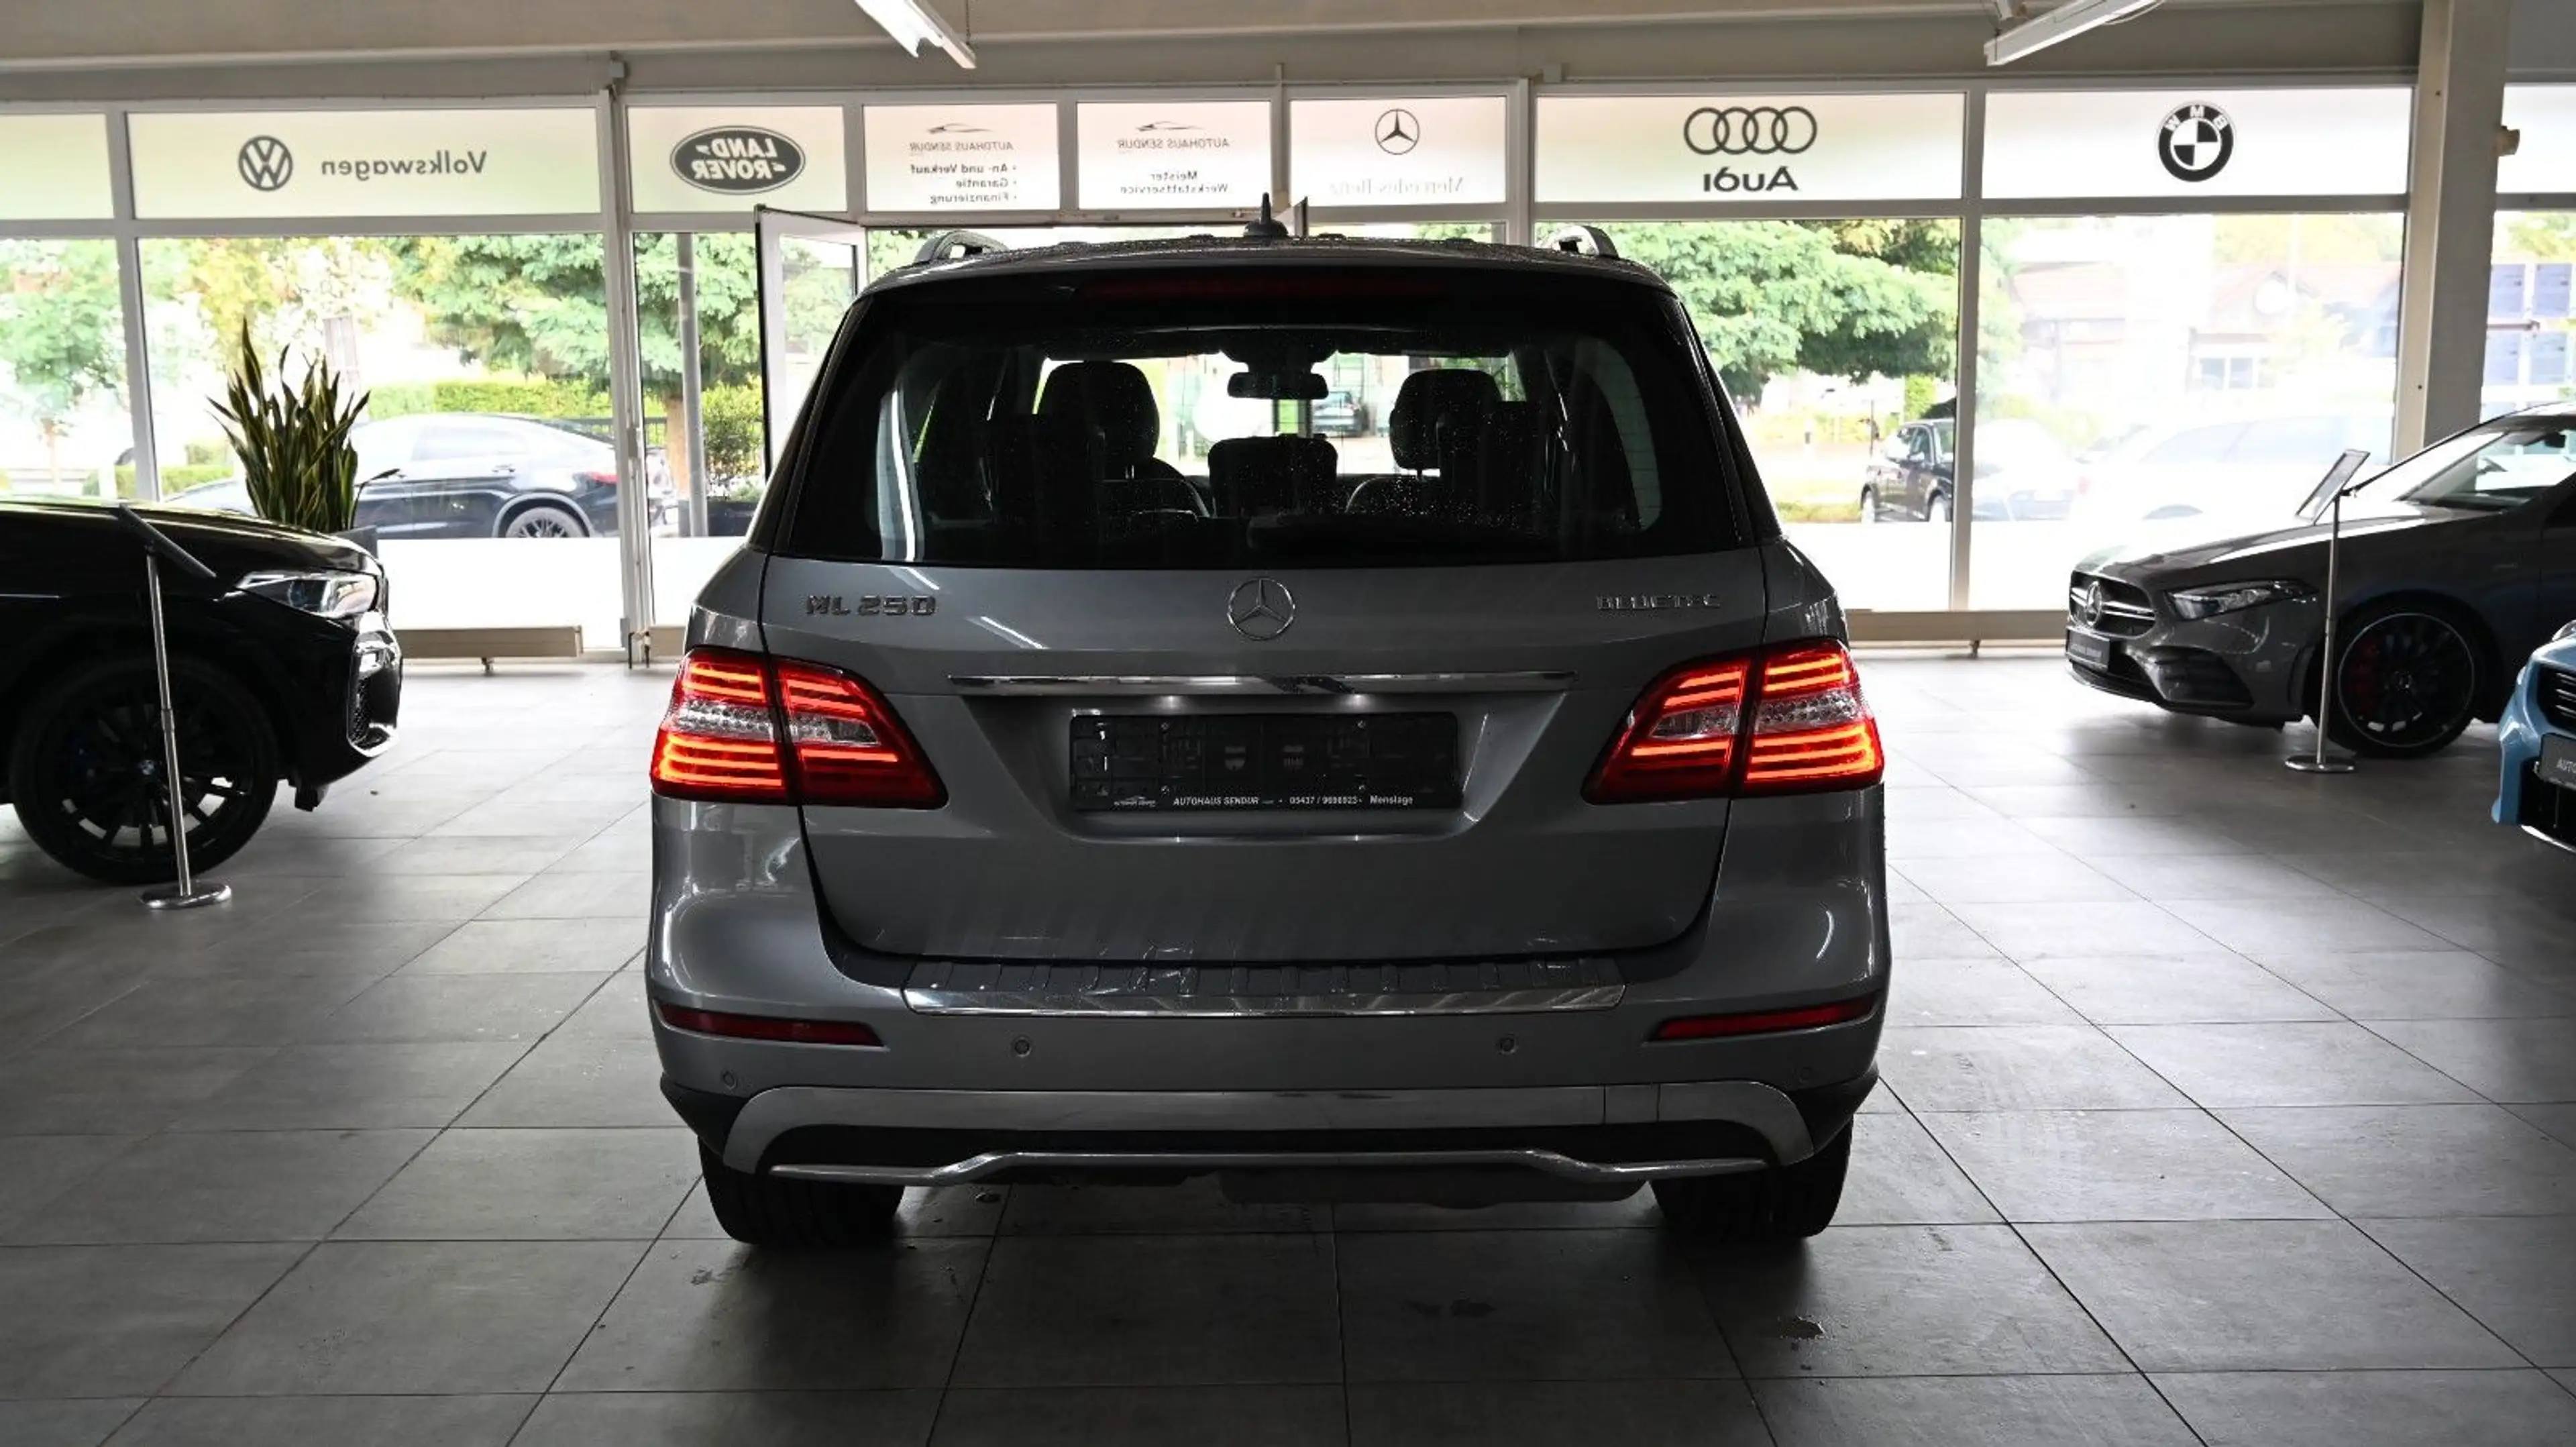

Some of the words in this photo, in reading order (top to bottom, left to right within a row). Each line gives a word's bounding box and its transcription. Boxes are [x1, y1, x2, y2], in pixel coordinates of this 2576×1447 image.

[806, 594, 851, 615] ML
[857, 594, 936, 616] 250
[1173, 796, 1222, 806] AUTOHAUS
